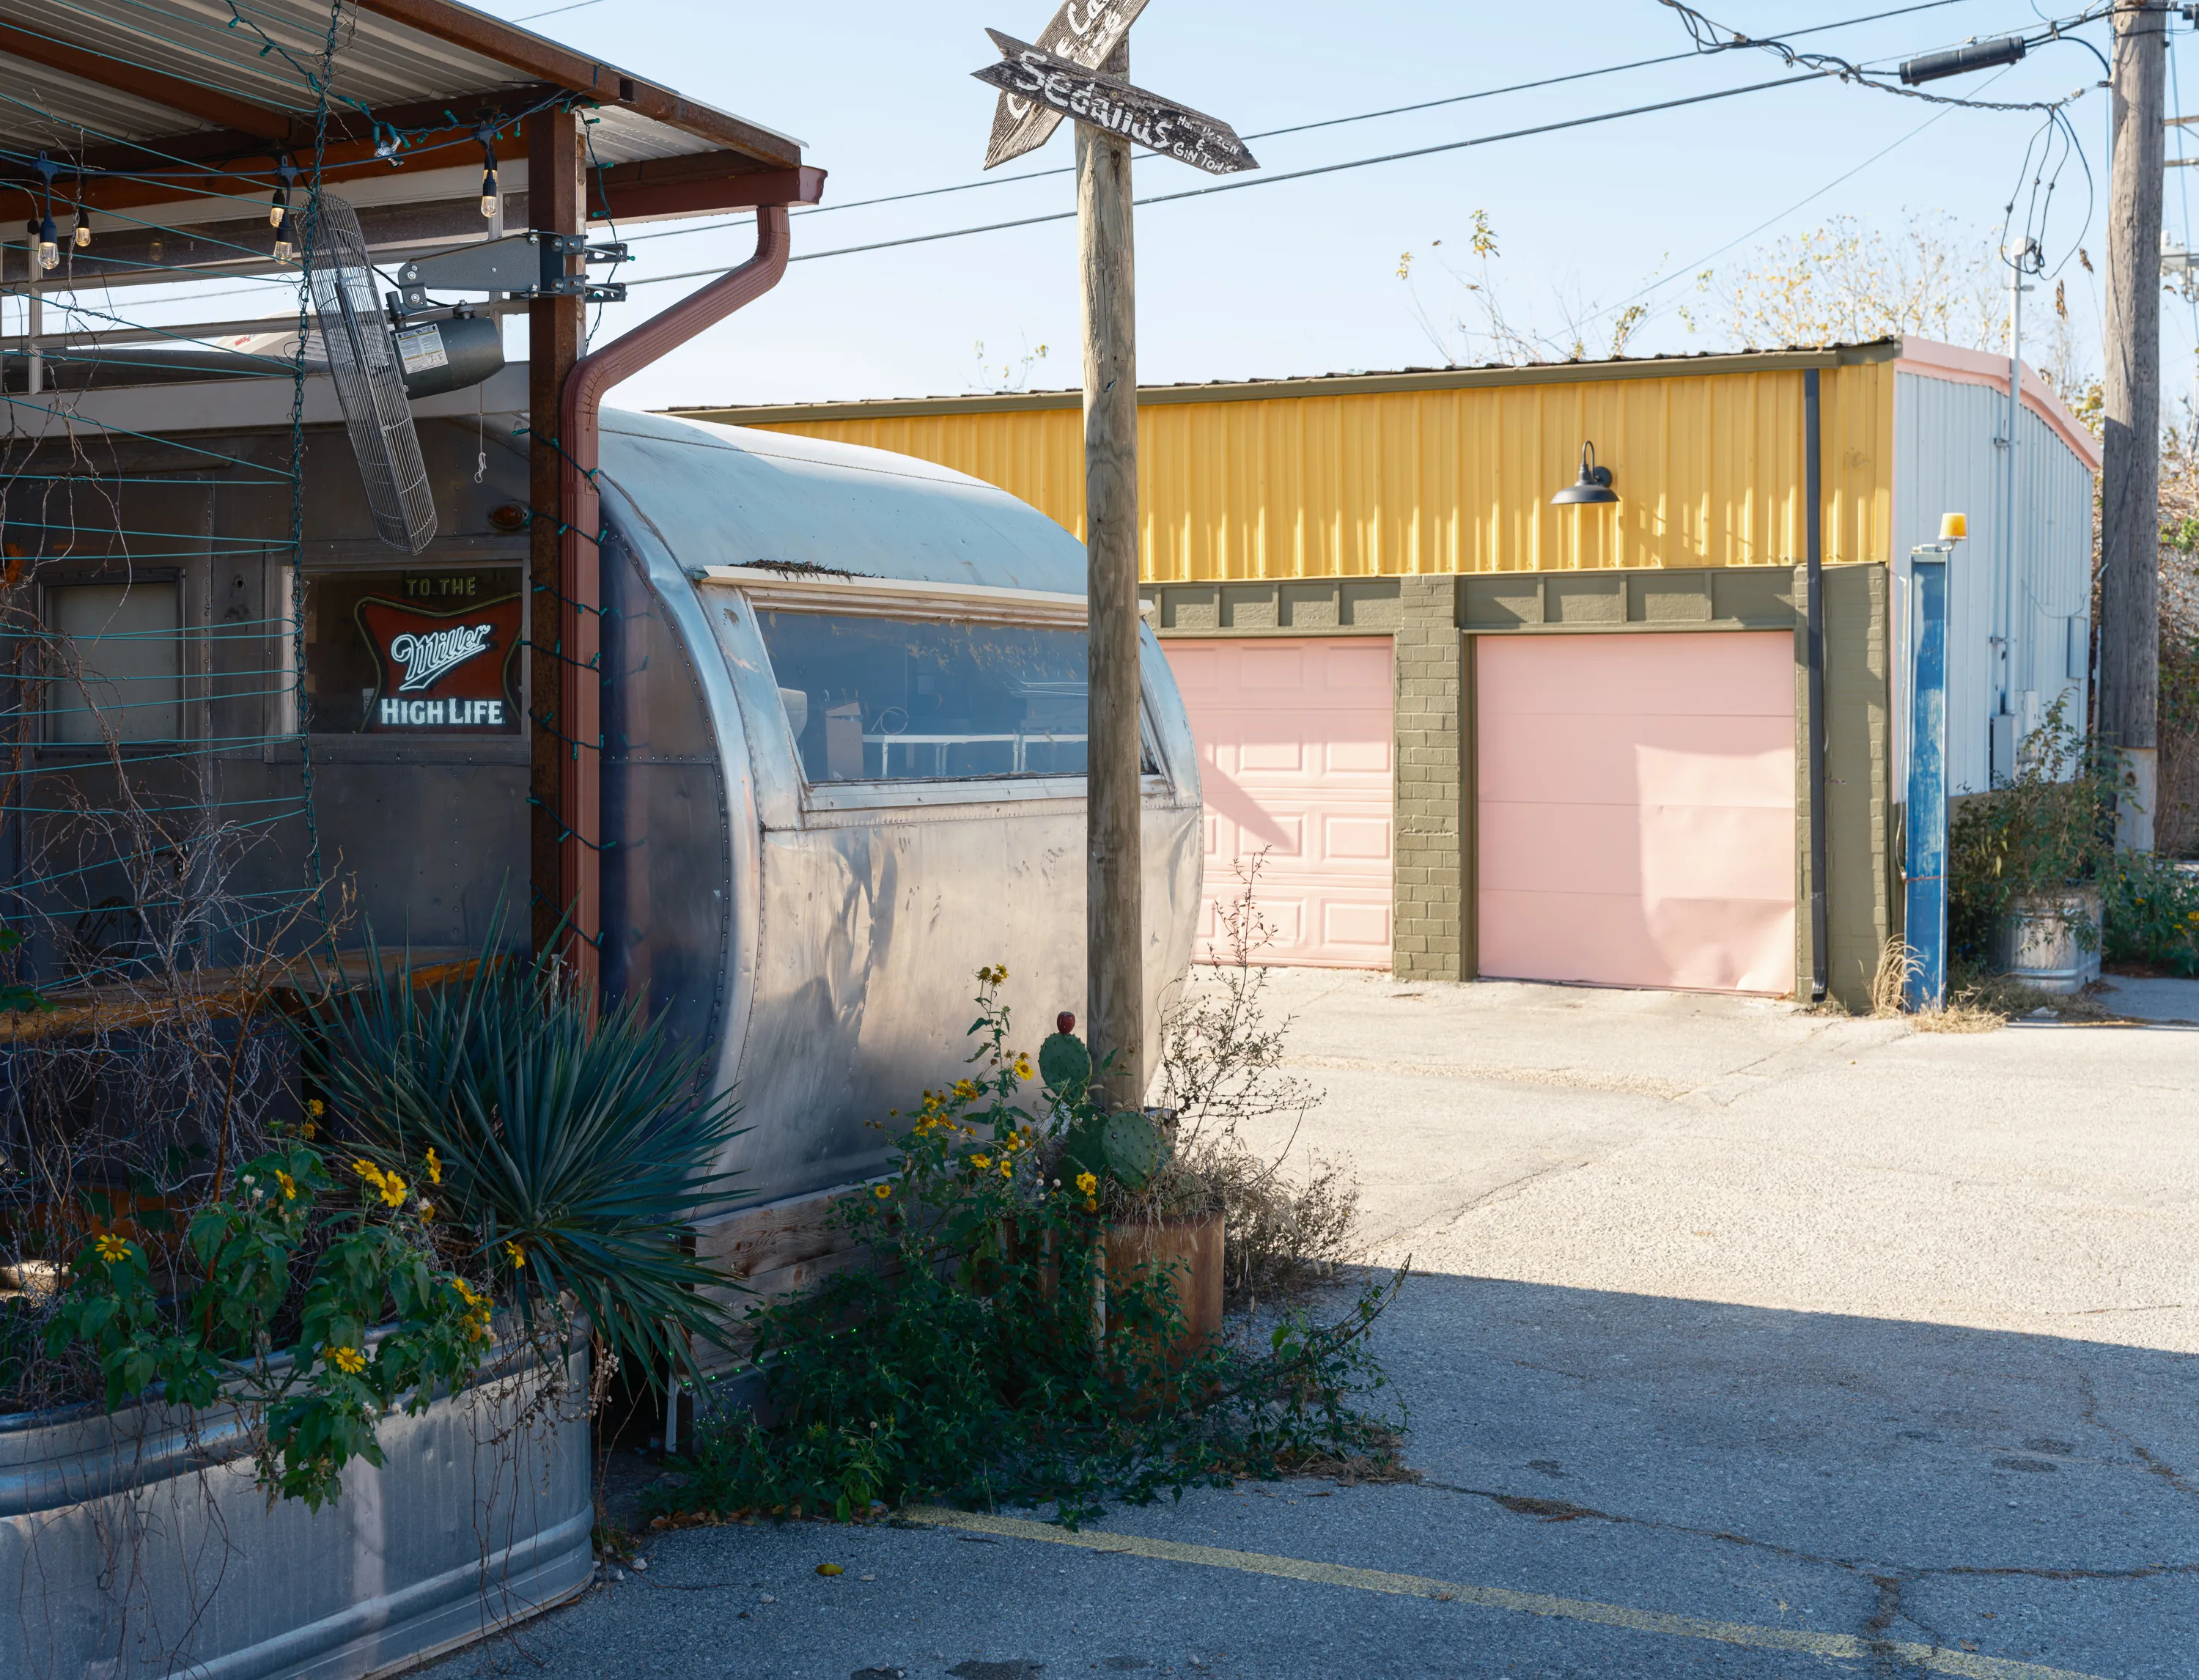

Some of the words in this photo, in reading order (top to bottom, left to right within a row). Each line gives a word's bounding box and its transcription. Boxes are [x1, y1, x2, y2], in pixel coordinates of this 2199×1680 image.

[407, 578, 431, 596] TO
[439, 576, 476, 595] THE
[391, 625, 491, 682] Miller
[380, 699, 443, 724] HIGH
[449, 698, 503, 724] LIFE
